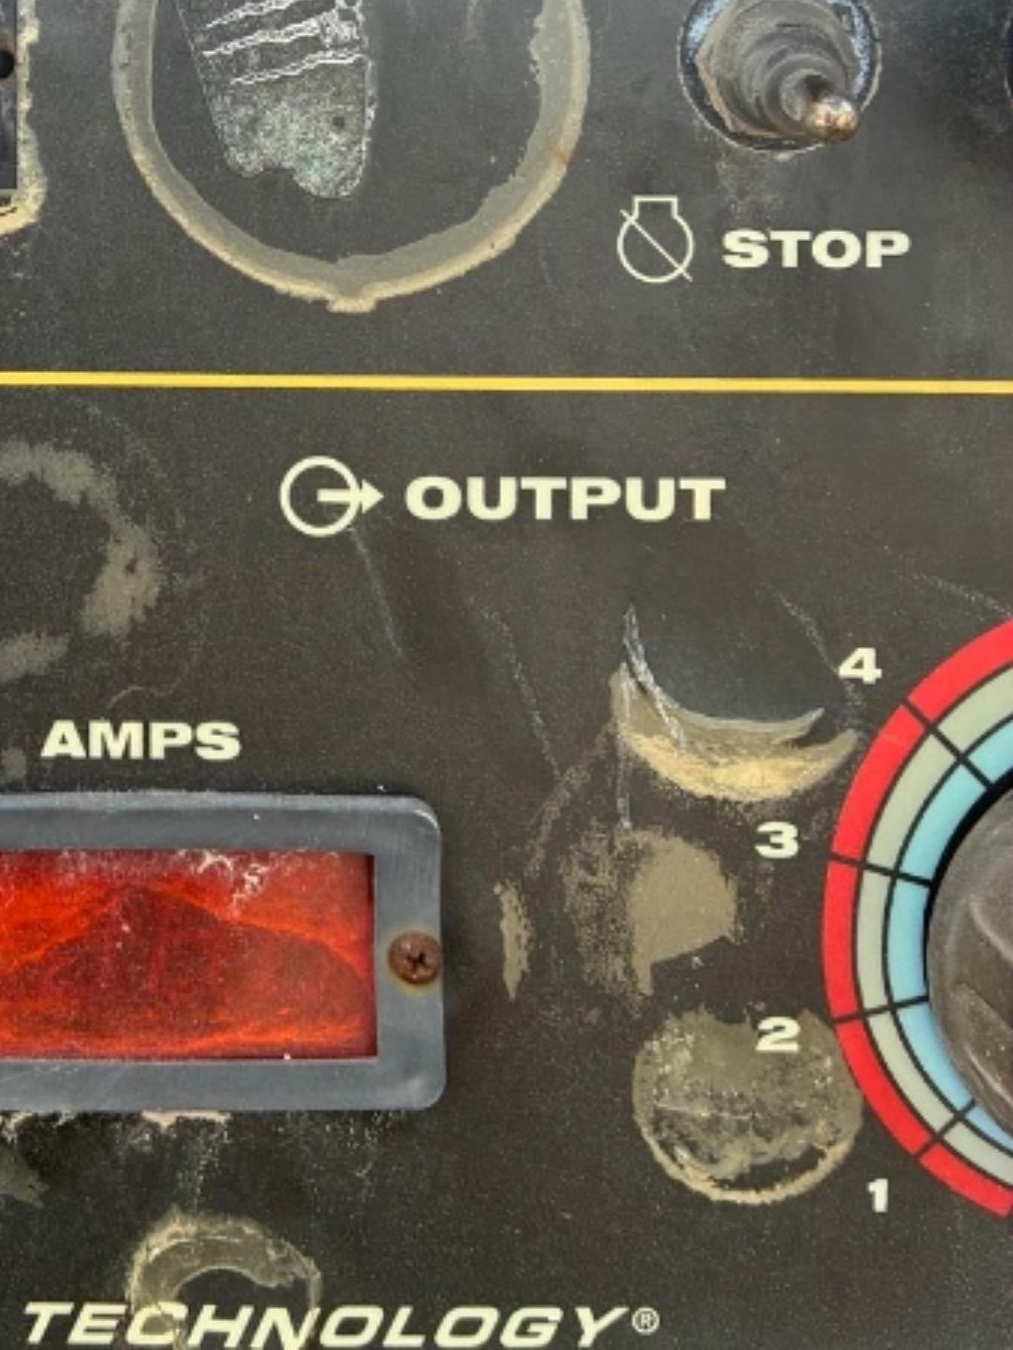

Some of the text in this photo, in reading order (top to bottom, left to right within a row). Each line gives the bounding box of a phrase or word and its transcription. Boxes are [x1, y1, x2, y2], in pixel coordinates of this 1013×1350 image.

[722, 228, 911, 268] STOP
[404, 476, 727, 521] OUTPUT
[838, 647, 882, 684] 4
[40, 720, 241, 761] AMPS
[756, 823, 800, 859] 3
[756, 1017, 801, 1052] 2
[868, 1179, 890, 1212] 1
